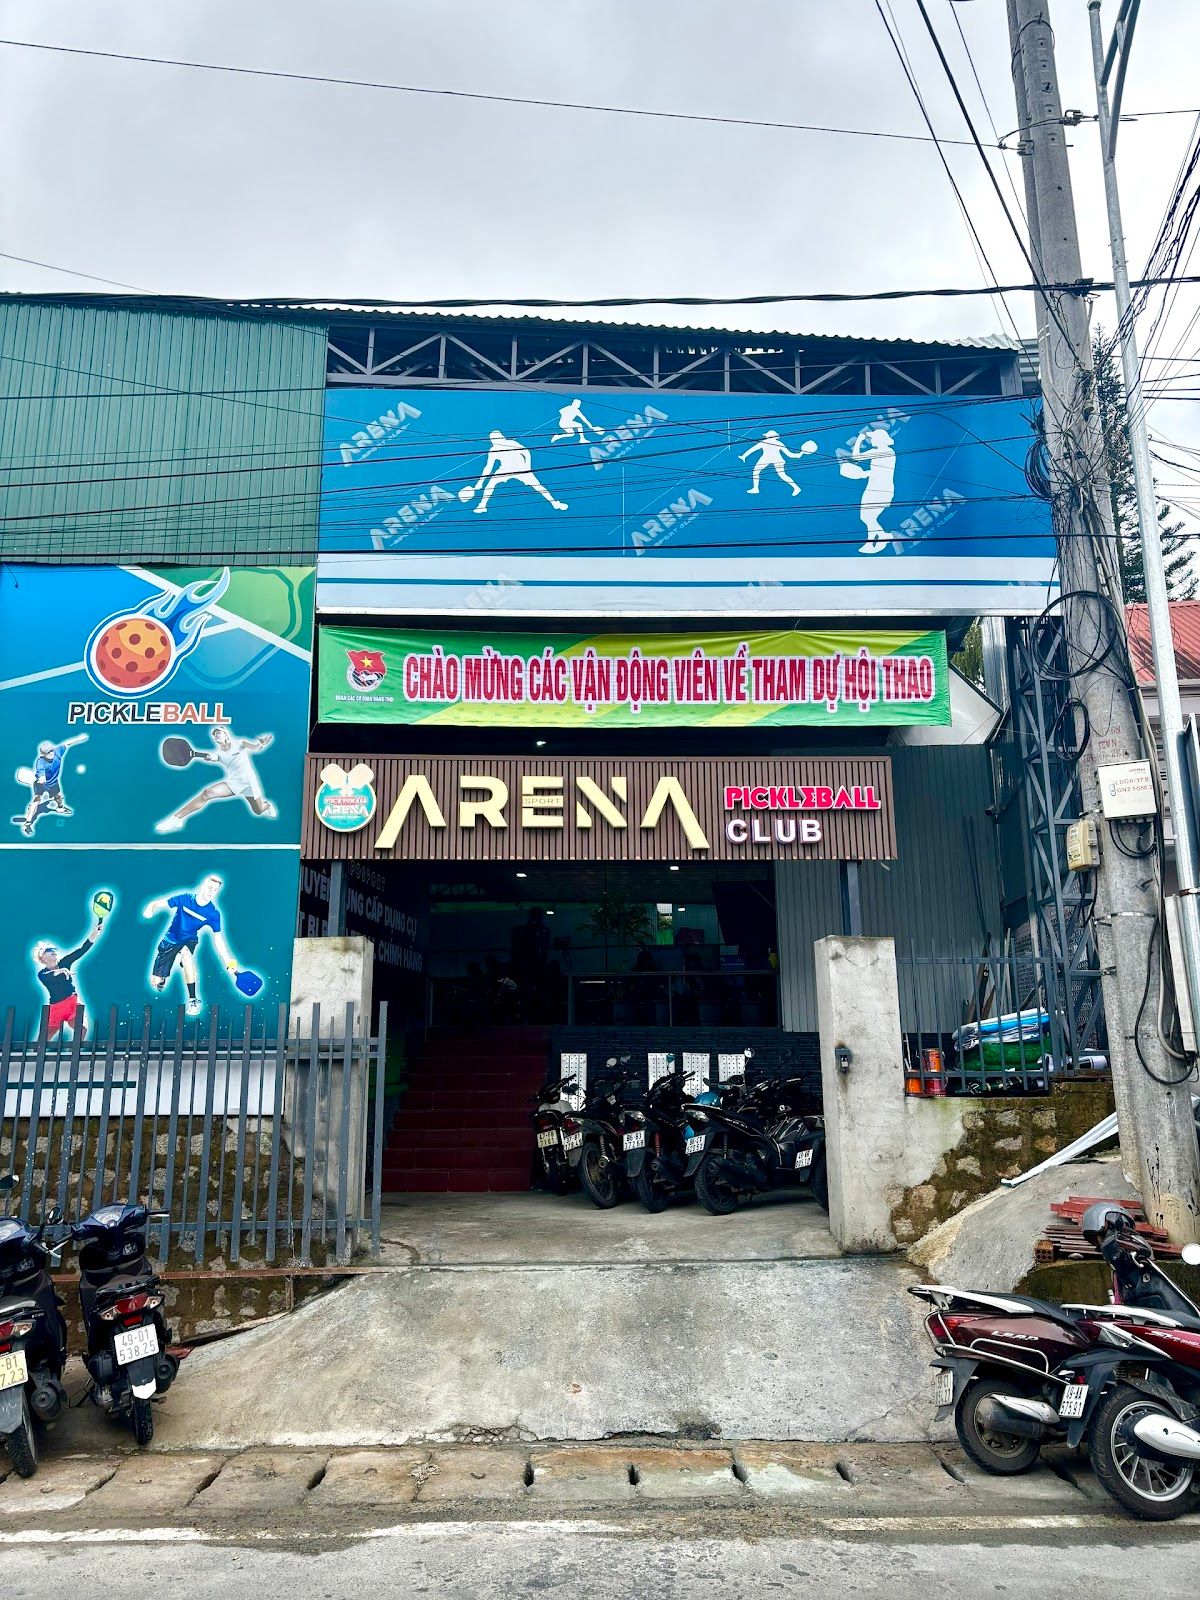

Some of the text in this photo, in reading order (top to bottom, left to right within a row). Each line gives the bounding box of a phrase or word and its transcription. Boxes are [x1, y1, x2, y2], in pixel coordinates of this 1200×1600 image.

[339, 401, 423, 467] ARENA
[589, 405, 669, 471] ARENA
[631, 488, 713, 557] ARENA
[404, 645, 933, 712] CHÀO MỪNG CÁC VẬN ĐỘNG VIÊN VỀ THAM DỰ HỘI THAO
[68, 702, 231, 725] PICKLEBALL
[322, 804, 370, 817] ARENA
[374, 774, 711, 850] ARENA
[523, 797, 562, 805] SPORT
[724, 785, 881, 811] PICKLEBALL
[726, 818, 823, 844] CLUB
[365, 896, 384, 924] CẤP
[384, 905, 406, 935] DỤNG
[119, 1342, 156, 1363] 538.25
